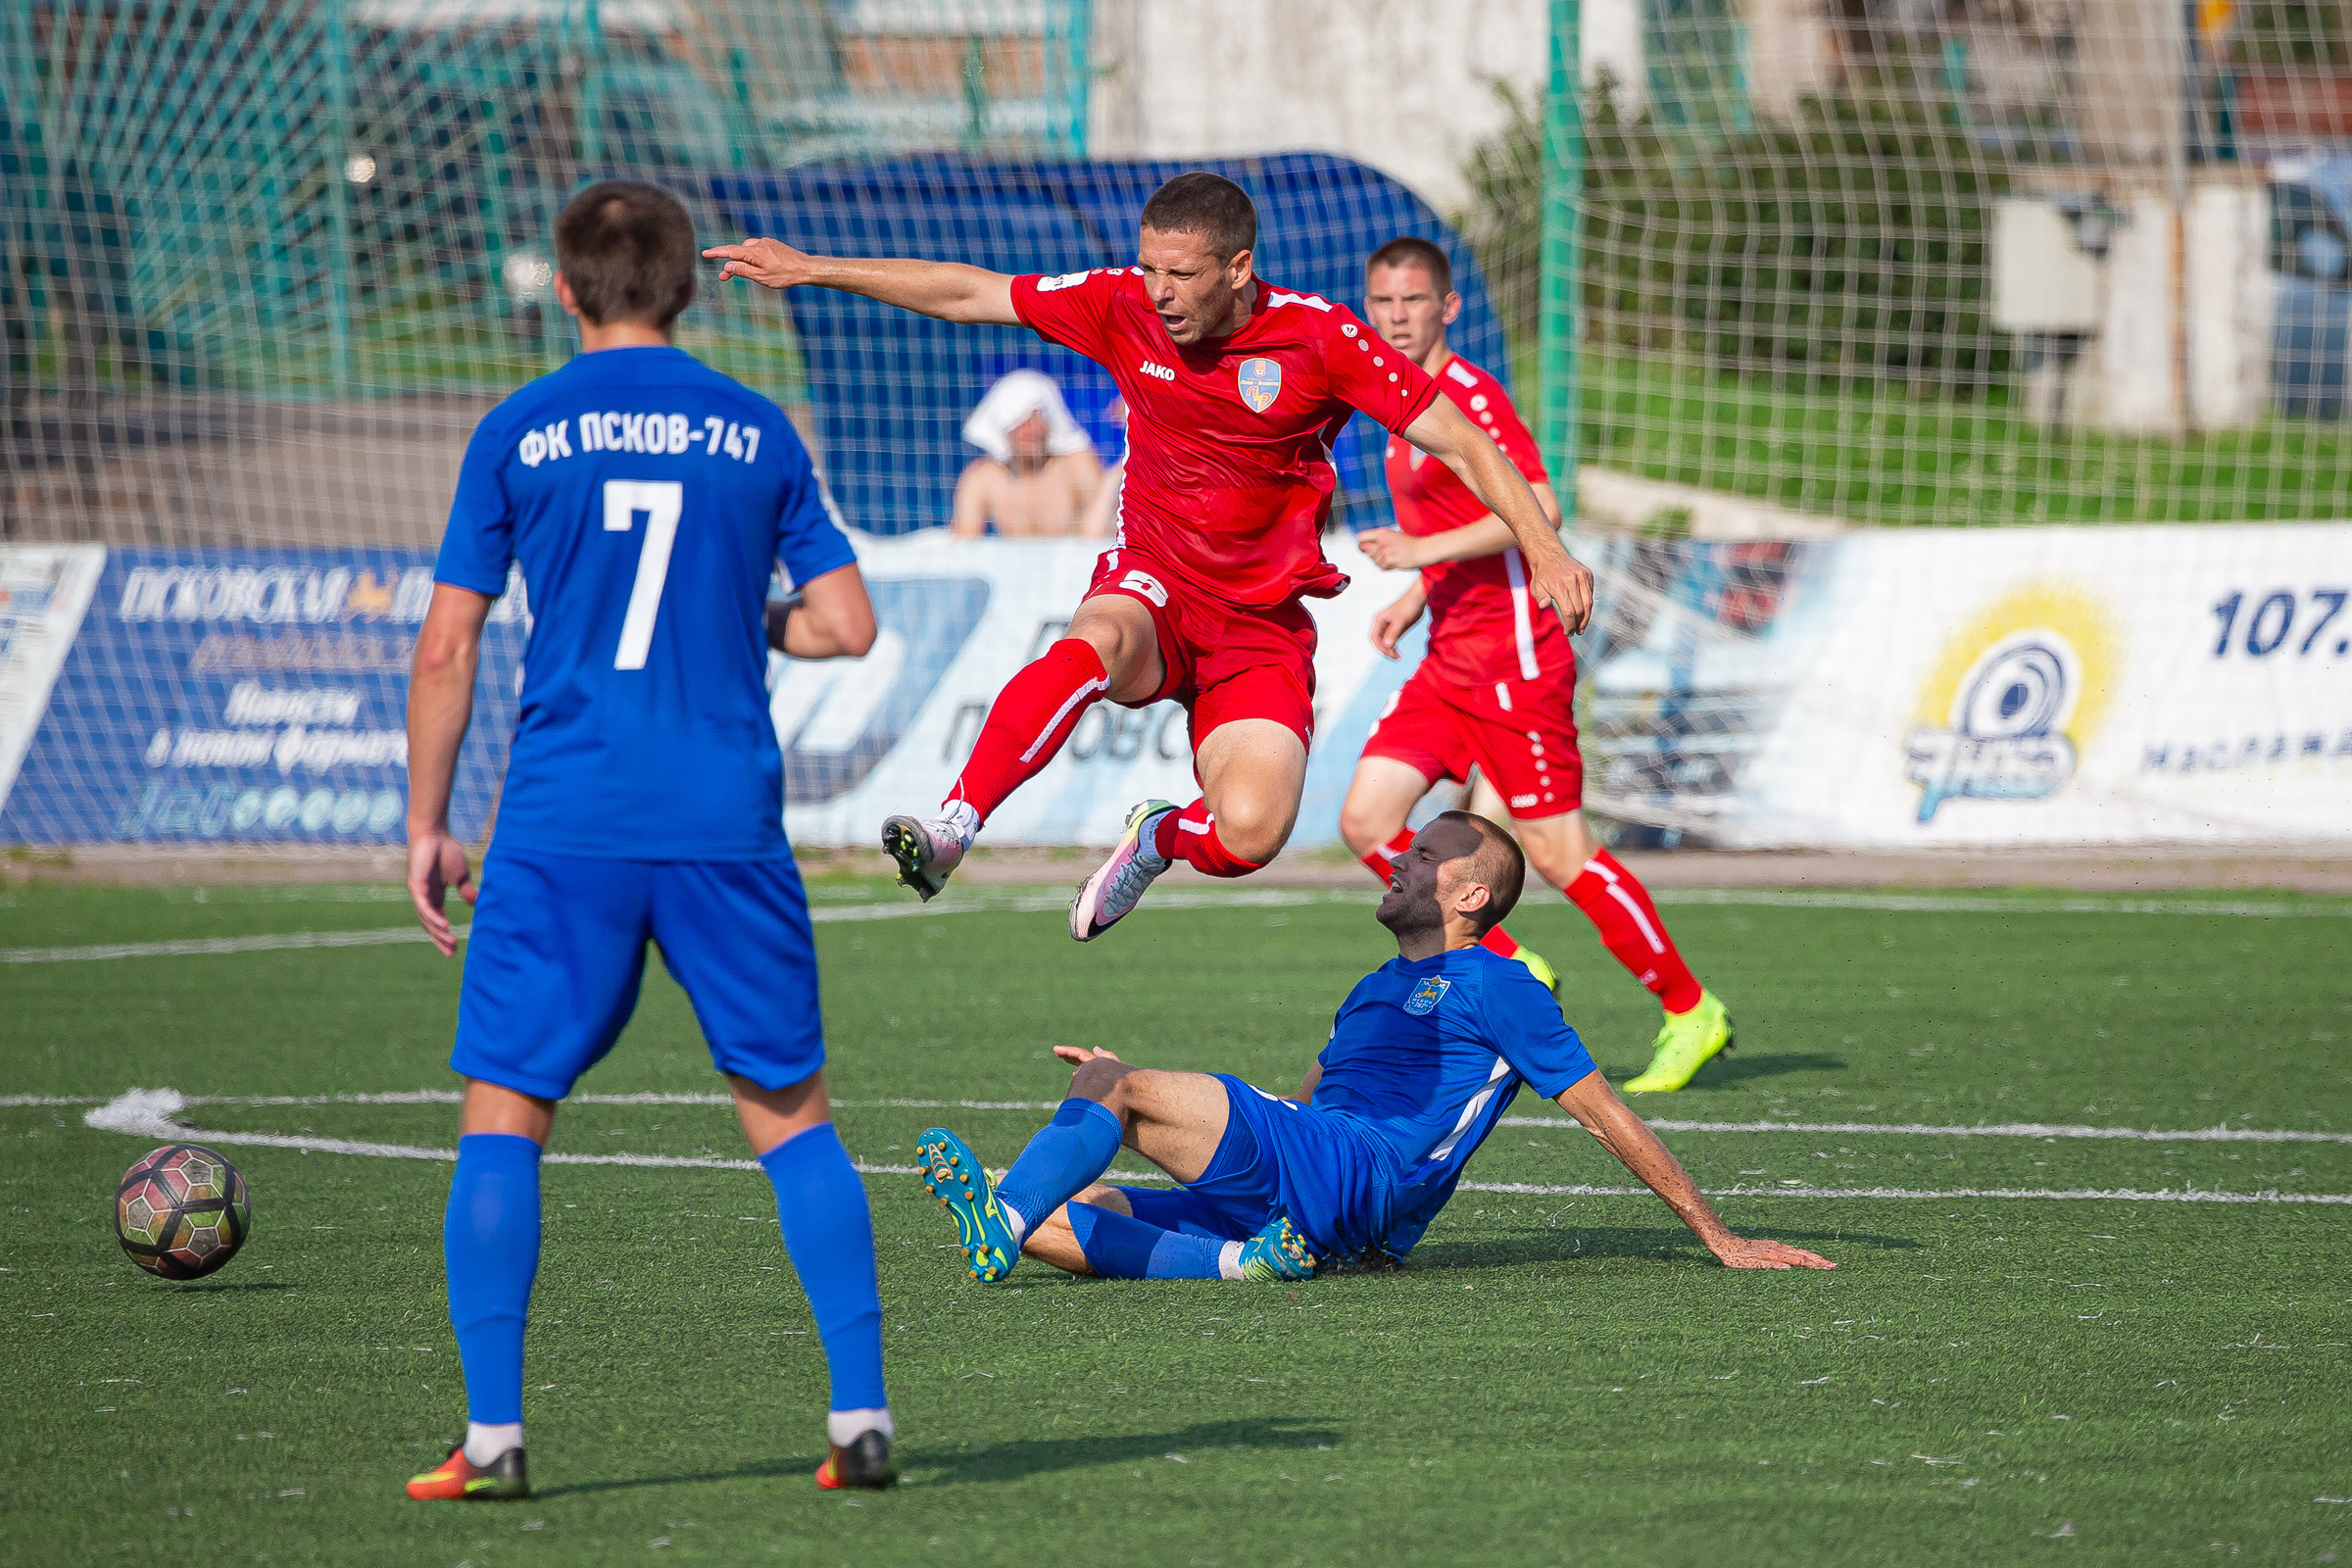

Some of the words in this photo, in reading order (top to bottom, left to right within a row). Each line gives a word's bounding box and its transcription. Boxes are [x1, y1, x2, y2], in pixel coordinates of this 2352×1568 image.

[1139, 360, 1176, 381] JAKO
[518, 420, 573, 467] ФК
[579, 411, 761, 465] ПСКОВ-747
[603, 478, 683, 671] 7
